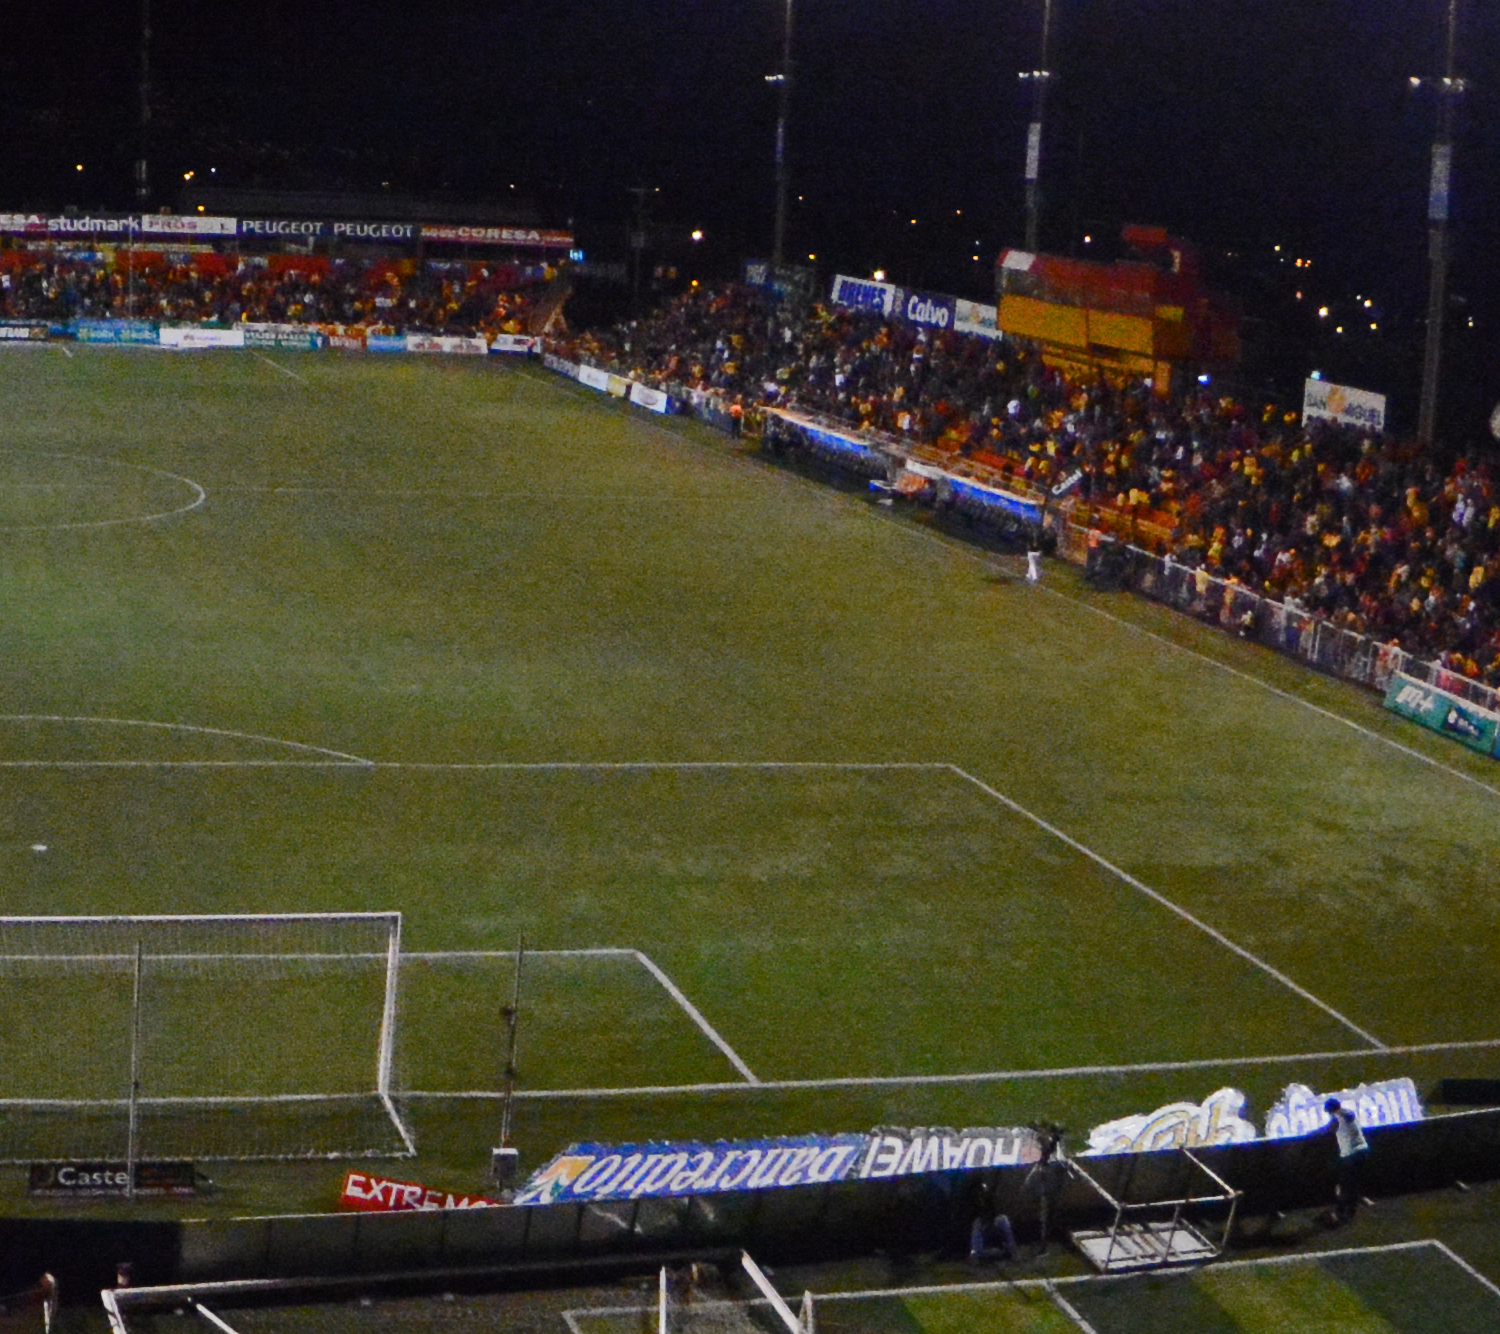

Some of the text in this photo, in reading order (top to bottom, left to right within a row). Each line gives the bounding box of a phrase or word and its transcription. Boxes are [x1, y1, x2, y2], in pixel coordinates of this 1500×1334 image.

[47, 216, 140, 232] studmark
[242, 220, 324, 235] PEUGEOT
[334, 222, 413, 238] PEUGEOT
[907, 296, 949, 327] Calvo
[862, 1136, 1021, 1178] HUAWEI
[57, 1167, 130, 1187] Caste
